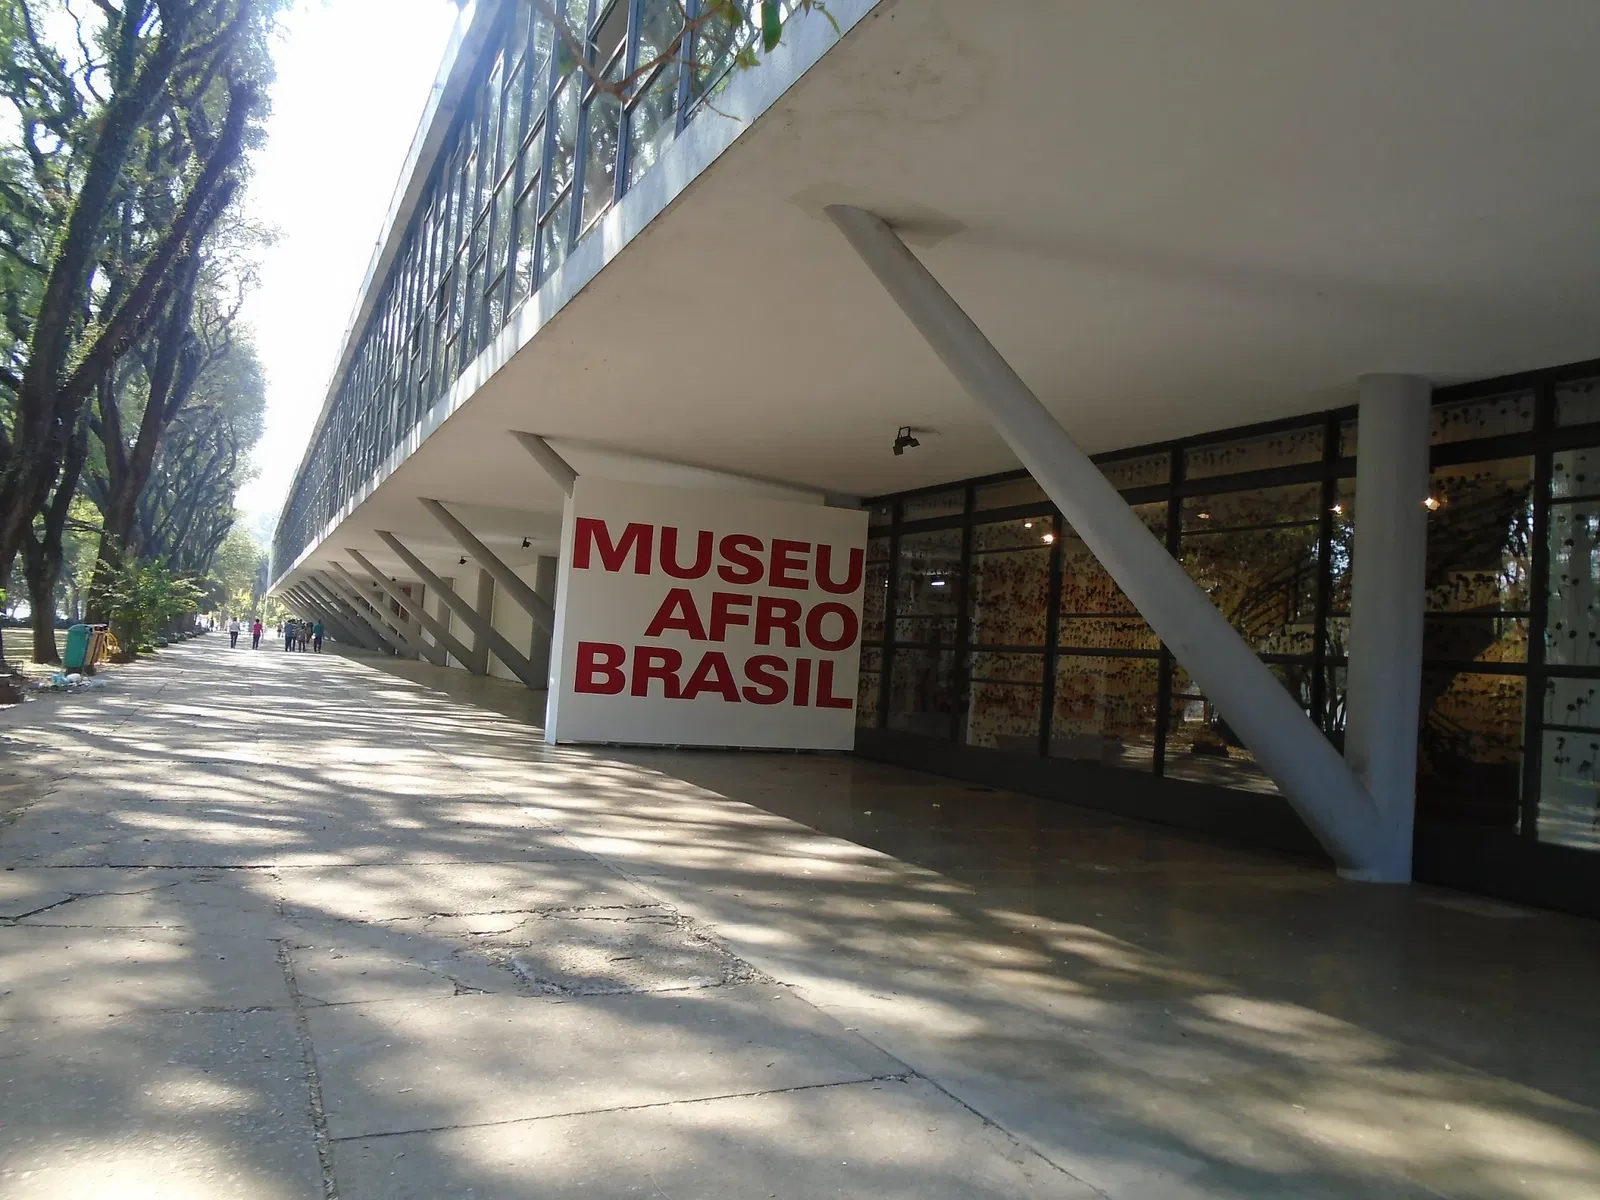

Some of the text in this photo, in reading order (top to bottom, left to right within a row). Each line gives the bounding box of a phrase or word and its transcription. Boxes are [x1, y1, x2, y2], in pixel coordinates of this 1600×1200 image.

[573, 517, 864, 595] MUSEU
[644, 588, 859, 652] AFRO
[574, 642, 853, 710] BRASIL
